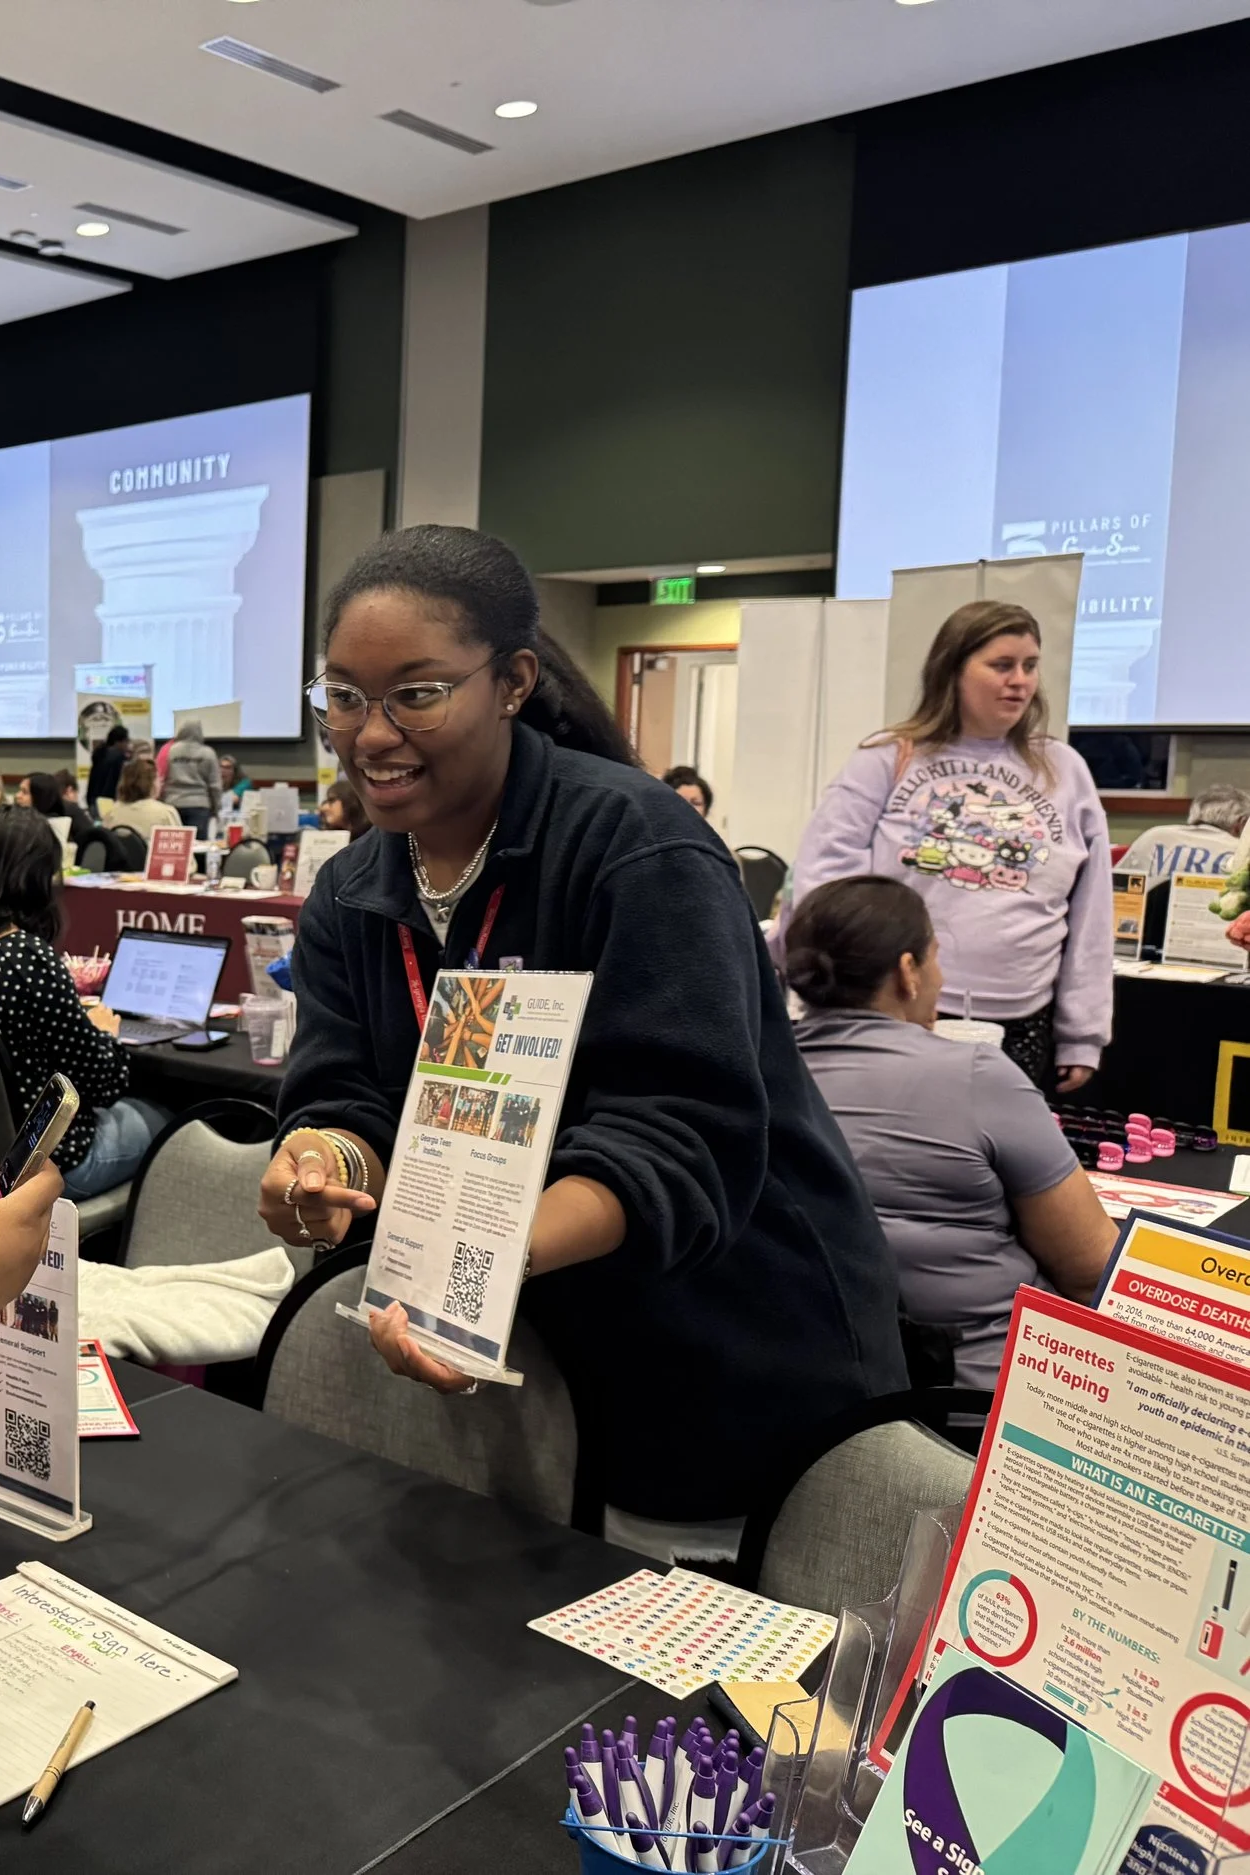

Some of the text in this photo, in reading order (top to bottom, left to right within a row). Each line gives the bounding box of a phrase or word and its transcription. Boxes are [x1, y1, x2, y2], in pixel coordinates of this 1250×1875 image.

[110, 452, 230, 494] COMMUNITY
[1052, 516, 1122, 535] PILLARS
[1130, 514, 1152, 529] OF
[928, 760, 979, 780] KITTY
[984, 764, 1020, 789] AND
[1018, 784, 1063, 845] FRIENDS
[527, 998, 565, 1011] GUIDE, Inc.
[495, 1033, 563, 1059] GET INVOLVED!
[420, 1133, 439, 1146] Georgia
[470, 1148, 507, 1166] Focus Groups
[387, 1231, 424, 1251] General Support
[1128, 1280, 1199, 1313] OVERDOSE
[1116, 1302, 1124, 1310] In
[1125, 1304, 1143, 1318] 2016,
[1145, 1314, 1165, 1326] more
[1166, 1320, 1183, 1333] than
[1184, 1327, 1215, 1343] 64,000
[1130, 1316, 1148, 1330] from
[1168, 1331, 1207, 1351] overdoses
[1208, 1345, 1224, 1358] and
[20, 1343, 47, 1358] Support
[1022, 1324, 1115, 1373] E-cigarettes
[1017, 1351, 1109, 1403] and Vaping
[1125, 1351, 1233, 1399] E-cigarette use, also known as
[1128, 1366, 1244, 1418] avoidable health risk to young
[1025, 1382, 1045, 1397] Today,
[1046, 1392, 1063, 1404] more
[1064, 1400, 1087, 1414] middle
[1088, 1410, 1102, 1420] and
[1102, 1414, 1119, 1428] high
[1120, 1423, 1143, 1438] school
[1144, 1434, 1175, 1452] students
[1176, 1447, 1190, 1458] use
[1133, 1385, 1148, 1396] am
[1149, 1391, 1189, 1415] officially
[1190, 1405, 1236, 1434] declaring
[1137, 1402, 1165, 1418] youth
[1165, 1413, 1178, 1423] an
[1179, 1418, 1222, 1442] epidemic
[1224, 1434, 1234, 1446] in
[1042, 1401, 1054, 1412] The
[1055, 1408, 1066, 1417] use
[1067, 1413, 1075, 1421] of
[1075, 1417, 1115, 1438] e-cigarettes
[1116, 1432, 1122, 1441] is
[1123, 1435, 1146, 1452] higher
[1147, 1448, 1173, 1465] among
[1174, 1457, 1192, 1472] high
[1193, 1467, 1219, 1483] school
[1055, 1418, 1234, 1505] Those who vape are 4x more likely to start smoking
[1075, 1439, 1093, 1453] Most
[1093, 1449, 1111, 1461] adult
[1112, 1457, 1141, 1475] smokers
[1142, 1471, 1169, 1487] started
[1169, 1481, 1194, 1499] before
[1195, 1492, 1208, 1505] the
[1210, 1501, 1224, 1512] age
[1226, 1508, 1235, 1517] of
[1070, 1456, 1246, 1548] WHAT IS AN E-CIGARETTE?
[995, 1591, 1011, 1605] 63%
[996, 1604, 1023, 1623] e-cigarette
[48, 1618, 84, 1641] PLEASE
[975, 1609, 1015, 1638] that the product
[1072, 1608, 1160, 1664] BY THE NUMBERS:
[60, 1644, 97, 1667] EMAIL:
[92, 1630, 129, 1656] Sign
[1062, 1634, 1101, 1662] 3.6 million
[1189, 1761, 1228, 1791] doubled
[661, 1816, 675, 1843] GIDE,
[903, 1808, 933, 1842] See
[932, 1835, 945, 1853] a
